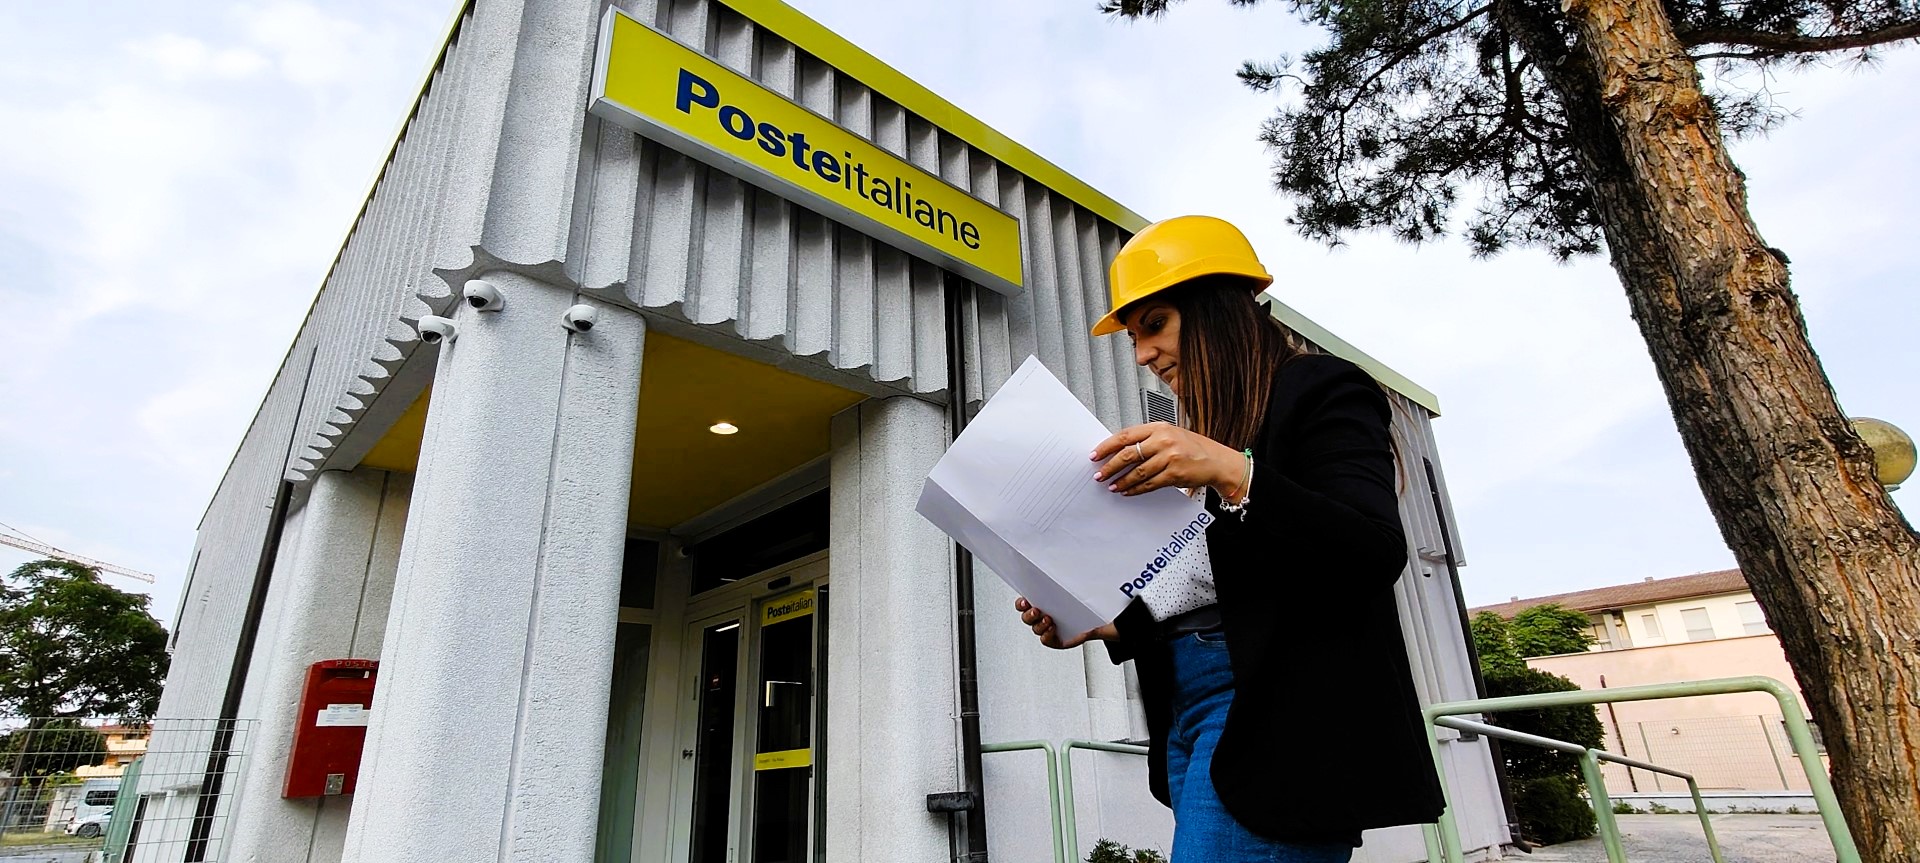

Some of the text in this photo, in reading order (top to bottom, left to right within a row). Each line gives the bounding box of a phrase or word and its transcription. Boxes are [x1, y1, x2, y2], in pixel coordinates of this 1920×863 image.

[675, 67, 980, 250] Posteitaliane
[1119, 512, 1211, 599] Posteitaliane
[767, 597, 813, 619] Posteitalian
[336, 660, 375, 668] POSTE
